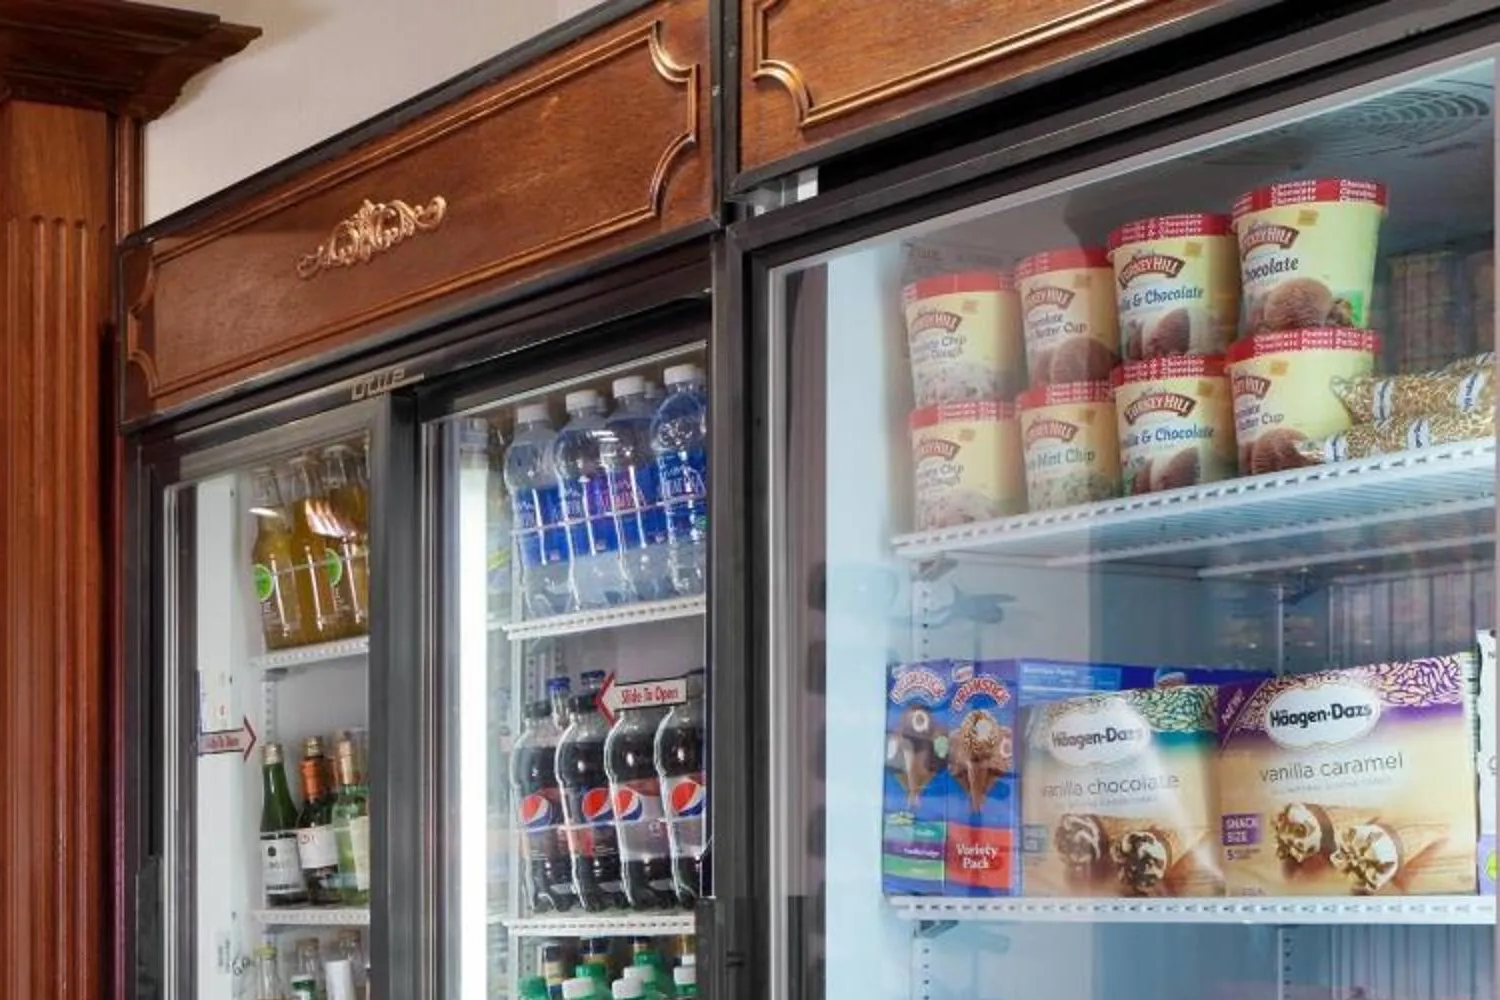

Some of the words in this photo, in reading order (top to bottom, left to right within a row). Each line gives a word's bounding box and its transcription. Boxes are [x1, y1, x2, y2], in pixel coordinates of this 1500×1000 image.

[1145, 285, 1204, 305] Chocolate
[1155, 423, 1213, 441] Chocolate
[1259, 755, 1314, 783] vanilla
[1320, 751, 1403, 778] caramel
[1227, 831, 1248, 844] SIZE
[956, 843, 998, 859] Variety
[963, 857, 989, 870] Pack
